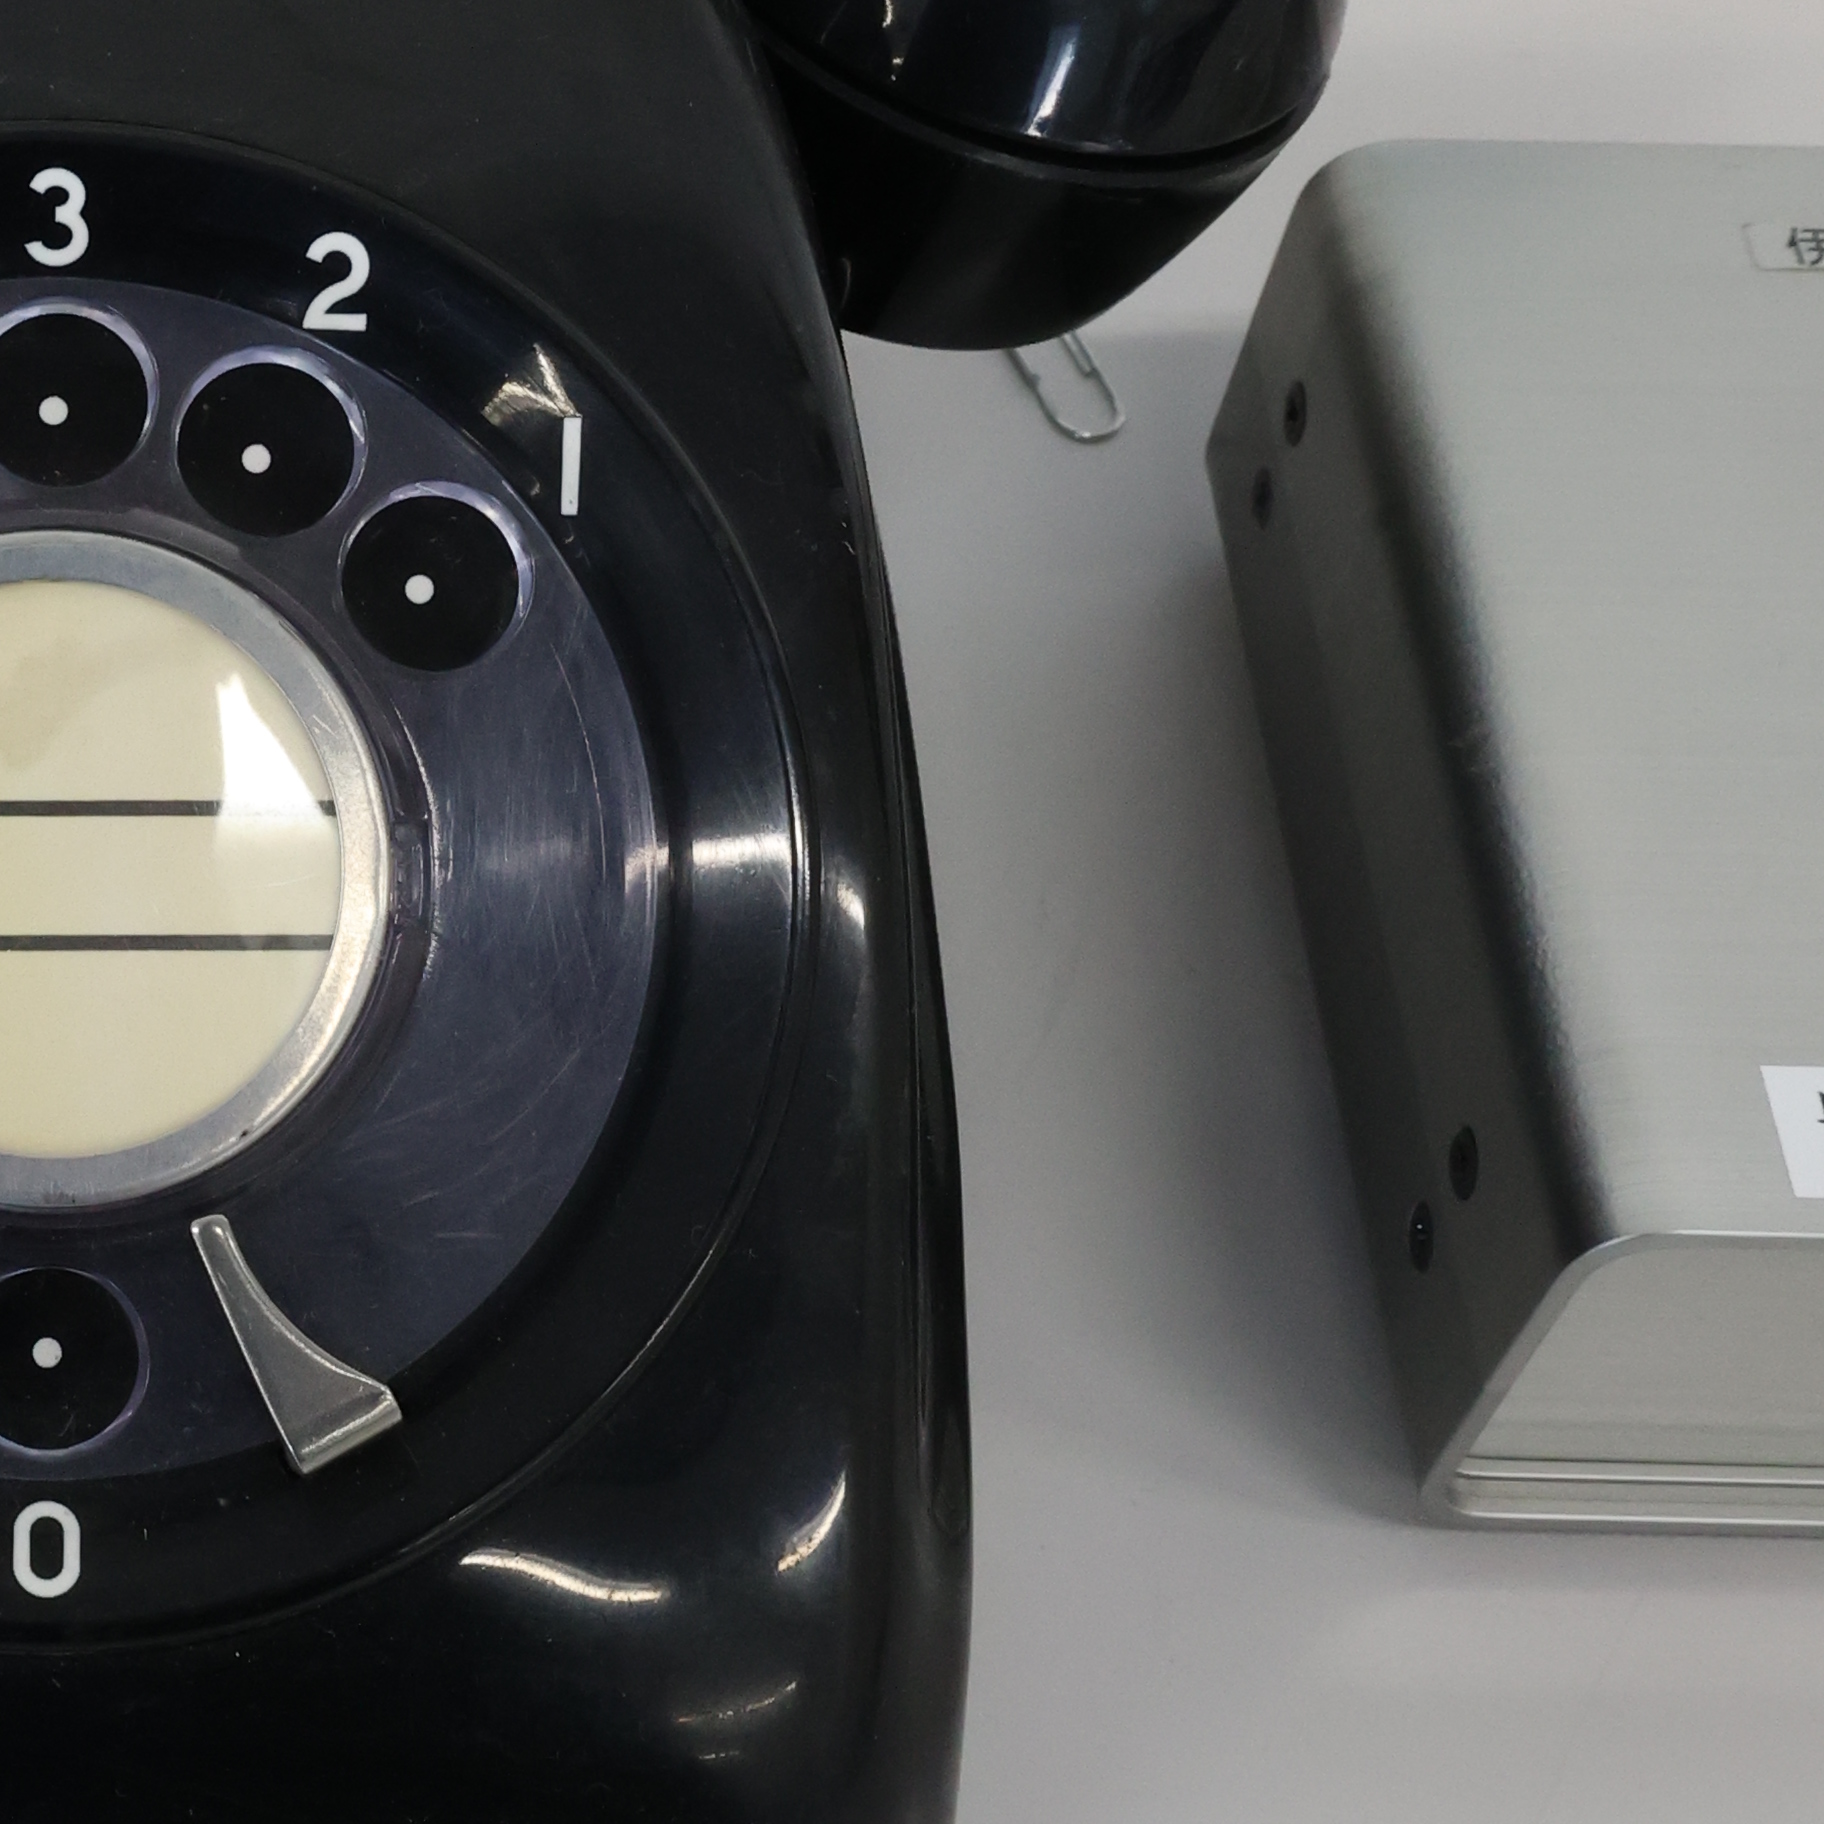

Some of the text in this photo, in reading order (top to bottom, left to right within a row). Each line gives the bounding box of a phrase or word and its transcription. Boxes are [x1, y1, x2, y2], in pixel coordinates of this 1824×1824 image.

[25, 169, 88, 266] 3
[303, 232, 369, 330] 2
[561, 417, 582, 516] 1
[14, 1502, 81, 1598] 0
